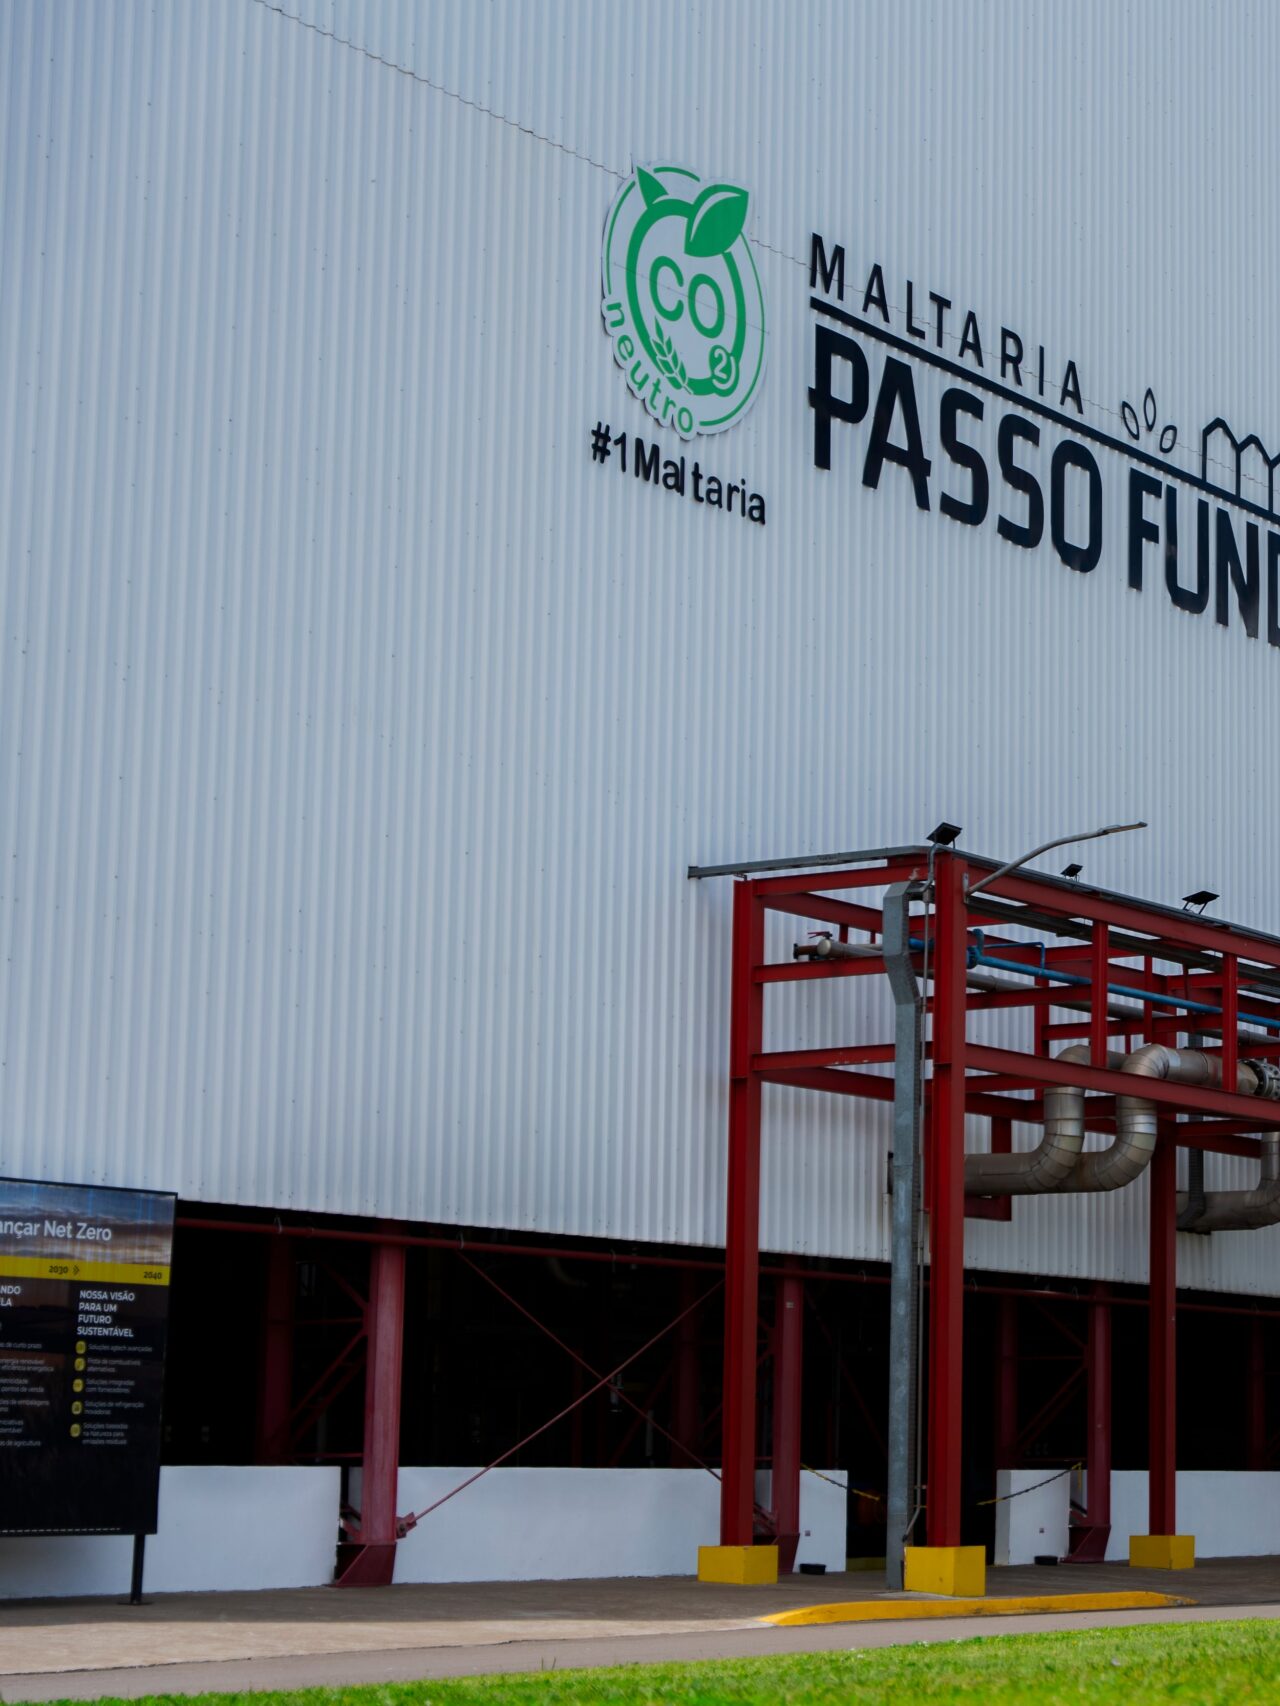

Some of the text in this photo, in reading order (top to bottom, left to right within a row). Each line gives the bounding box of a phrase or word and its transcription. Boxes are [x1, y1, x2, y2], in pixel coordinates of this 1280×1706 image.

[809, 232, 1085, 415] MALTARIA
[606, 301, 694, 434] neutro
[808, 323, 1103, 574] PASSO
[44, 1219, 73, 1239] Net
[76, 1222, 112, 1241] Zero
[48, 1265, 69, 1275] 2030
[143, 1271, 163, 1280] 2040
[79, 1290, 136, 1302] NOSSA VISÃO
[78, 1302, 118, 1313] PARA UM
[77, 1314, 112, 1324] FUTURO
[76, 1325, 134, 1337] SUSTENTÁVEL
